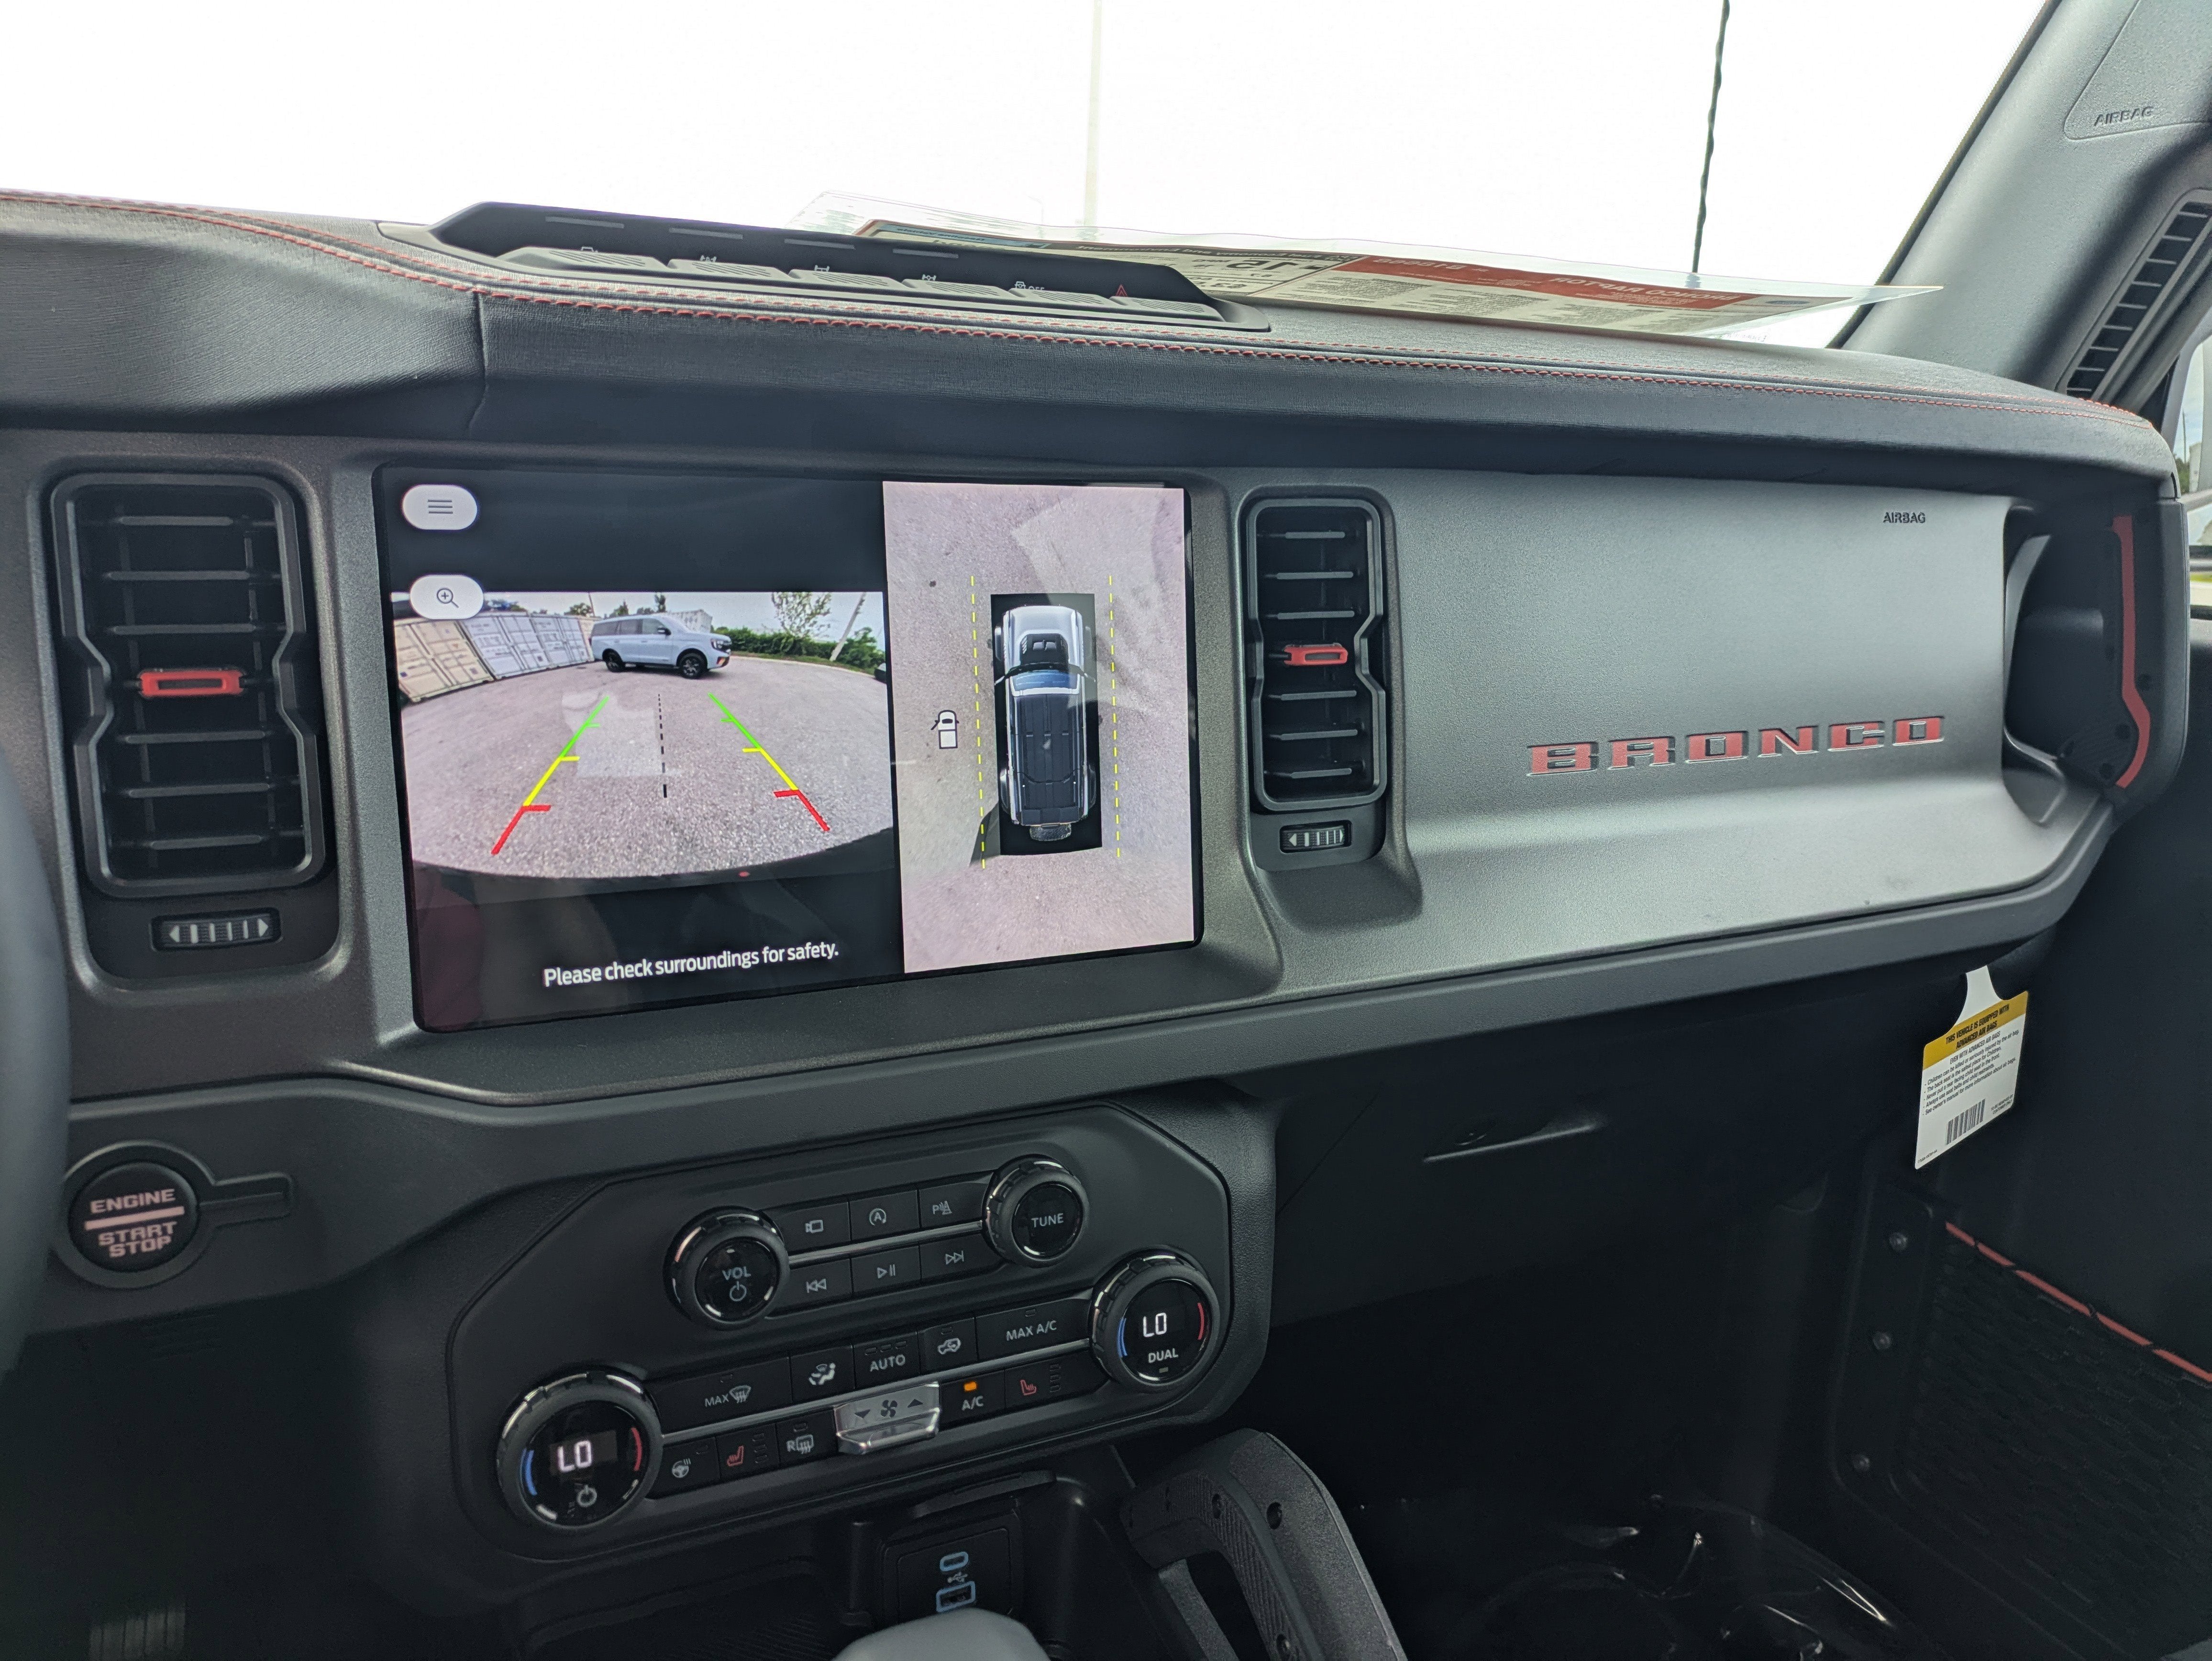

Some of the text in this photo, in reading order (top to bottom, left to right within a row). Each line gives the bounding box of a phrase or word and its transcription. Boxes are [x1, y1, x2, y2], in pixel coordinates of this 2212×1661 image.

[2094, 106, 2154, 127] AIRBAG
[1882, 510, 1926, 524] AIRBAG
[1526, 715, 1945, 777] BRONCO
[543, 941, 840, 987] Please check surroundings for safety.
[90, 1188, 177, 1214] ENGINE
[1030, 1212, 1064, 1229] TUNE
[98, 1220, 177, 1247] START
[108, 1236, 172, 1259] STOP
[722, 1266, 752, 1281] VOL
[1006, 1319, 1057, 1342] MAX A/C
[1142, 1312, 1168, 1339] LO
[869, 1354, 907, 1373] AUTO
[1148, 1349, 1179, 1363] DUAL
[704, 1393, 729, 1408] MAX
[961, 1395, 984, 1411] A/C
[556, 1439, 594, 1473] LO
